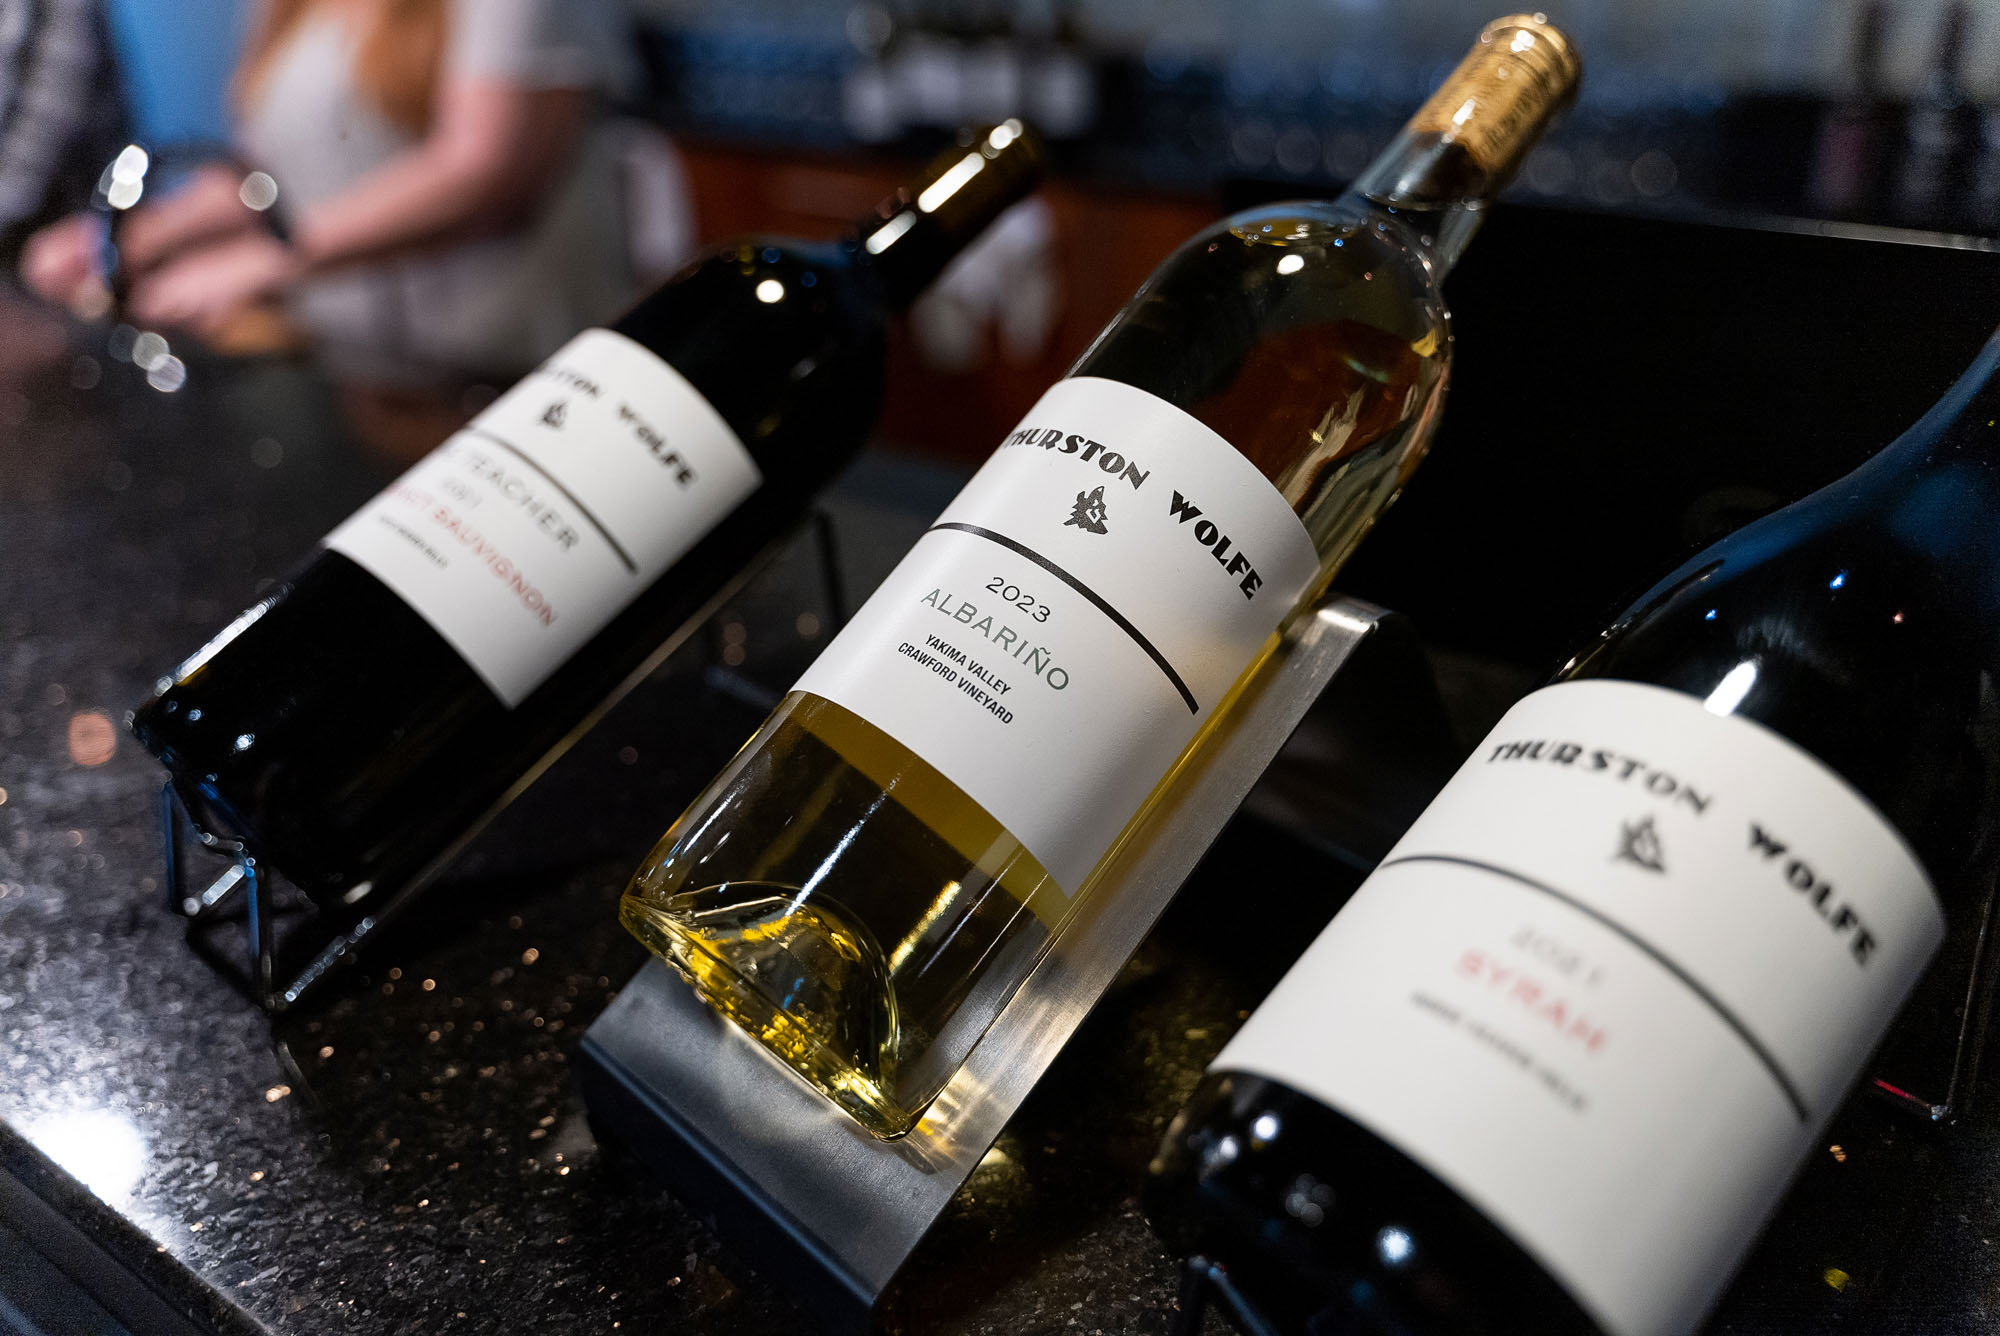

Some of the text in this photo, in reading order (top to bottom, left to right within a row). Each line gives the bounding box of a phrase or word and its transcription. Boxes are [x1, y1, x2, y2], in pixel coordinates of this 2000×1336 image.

[618, 403, 697, 487] WOLFE
[1004, 429, 1263, 600] THURSTON WOLFE
[431, 507, 558, 626] SAUVIGNON
[985, 577, 1051, 623] 2023
[898, 642, 1014, 724] CRAWFORD VINEYARD
[920, 588, 1069, 690] ALBARIÑO
[925, 634, 1011, 695] YAKIMA VALLEY
[1487, 739, 1878, 968] THURSTON WOLFE
[1455, 949, 1608, 1054] SYRAH
